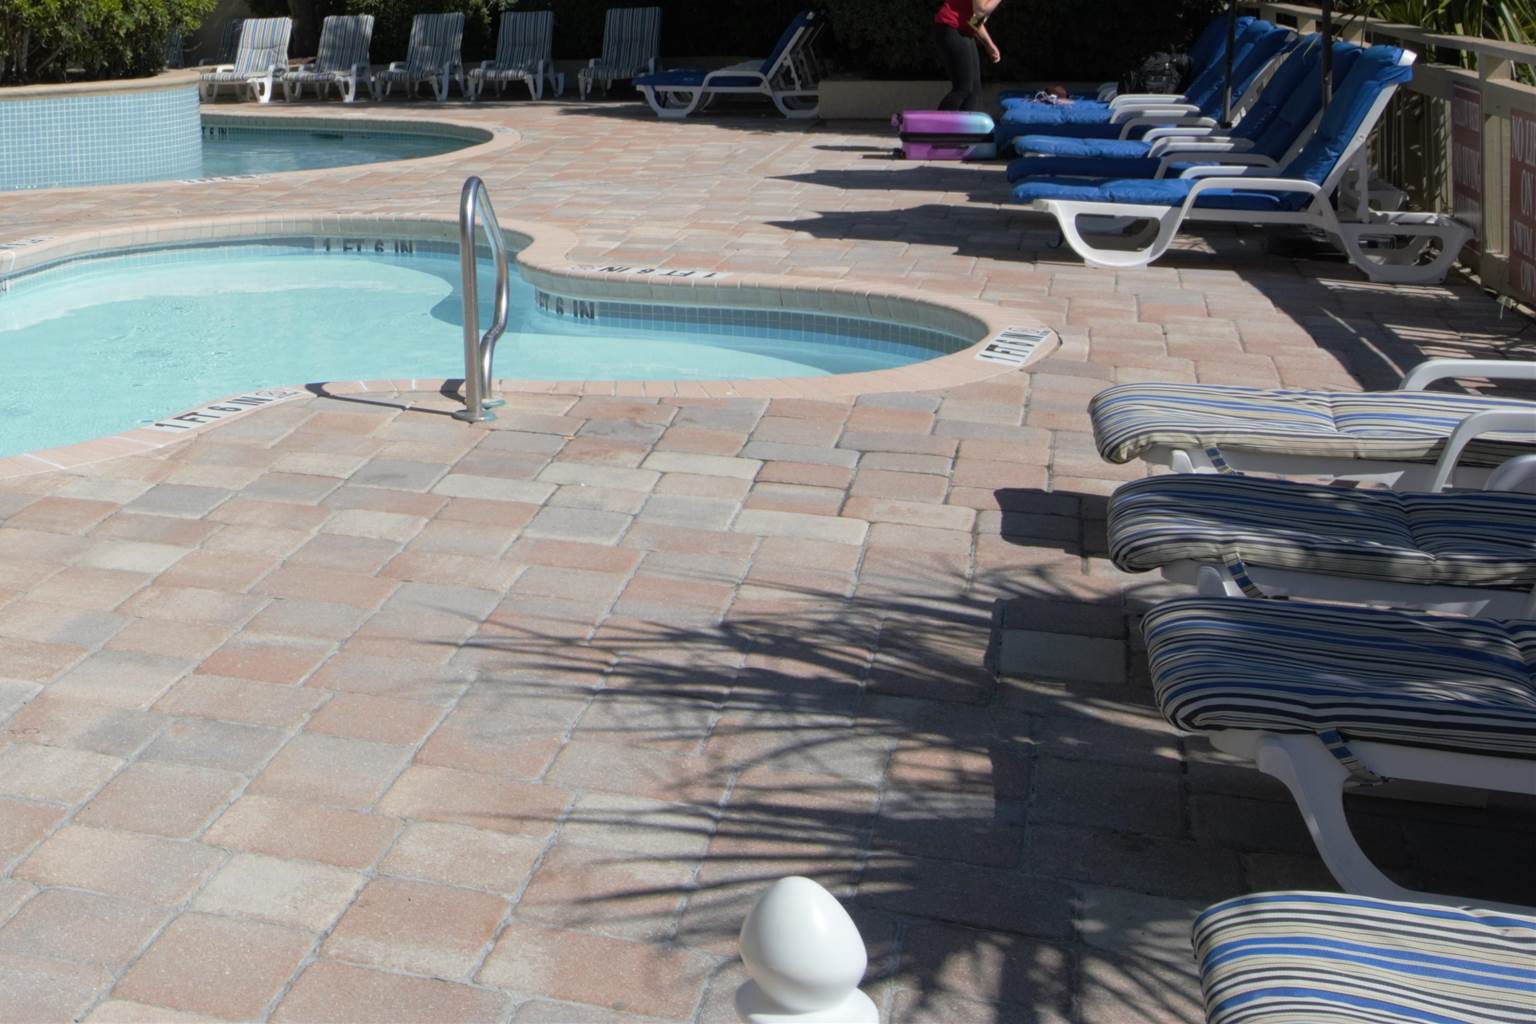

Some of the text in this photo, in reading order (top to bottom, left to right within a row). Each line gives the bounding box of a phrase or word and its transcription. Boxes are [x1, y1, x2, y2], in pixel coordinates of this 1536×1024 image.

[323, 238, 413, 253] 1 FT 6 IN
[556, 296, 564, 315] 6
[573, 299, 595, 320] IN
[173, 411, 221, 423] FT
[226, 396, 273, 406] IN
